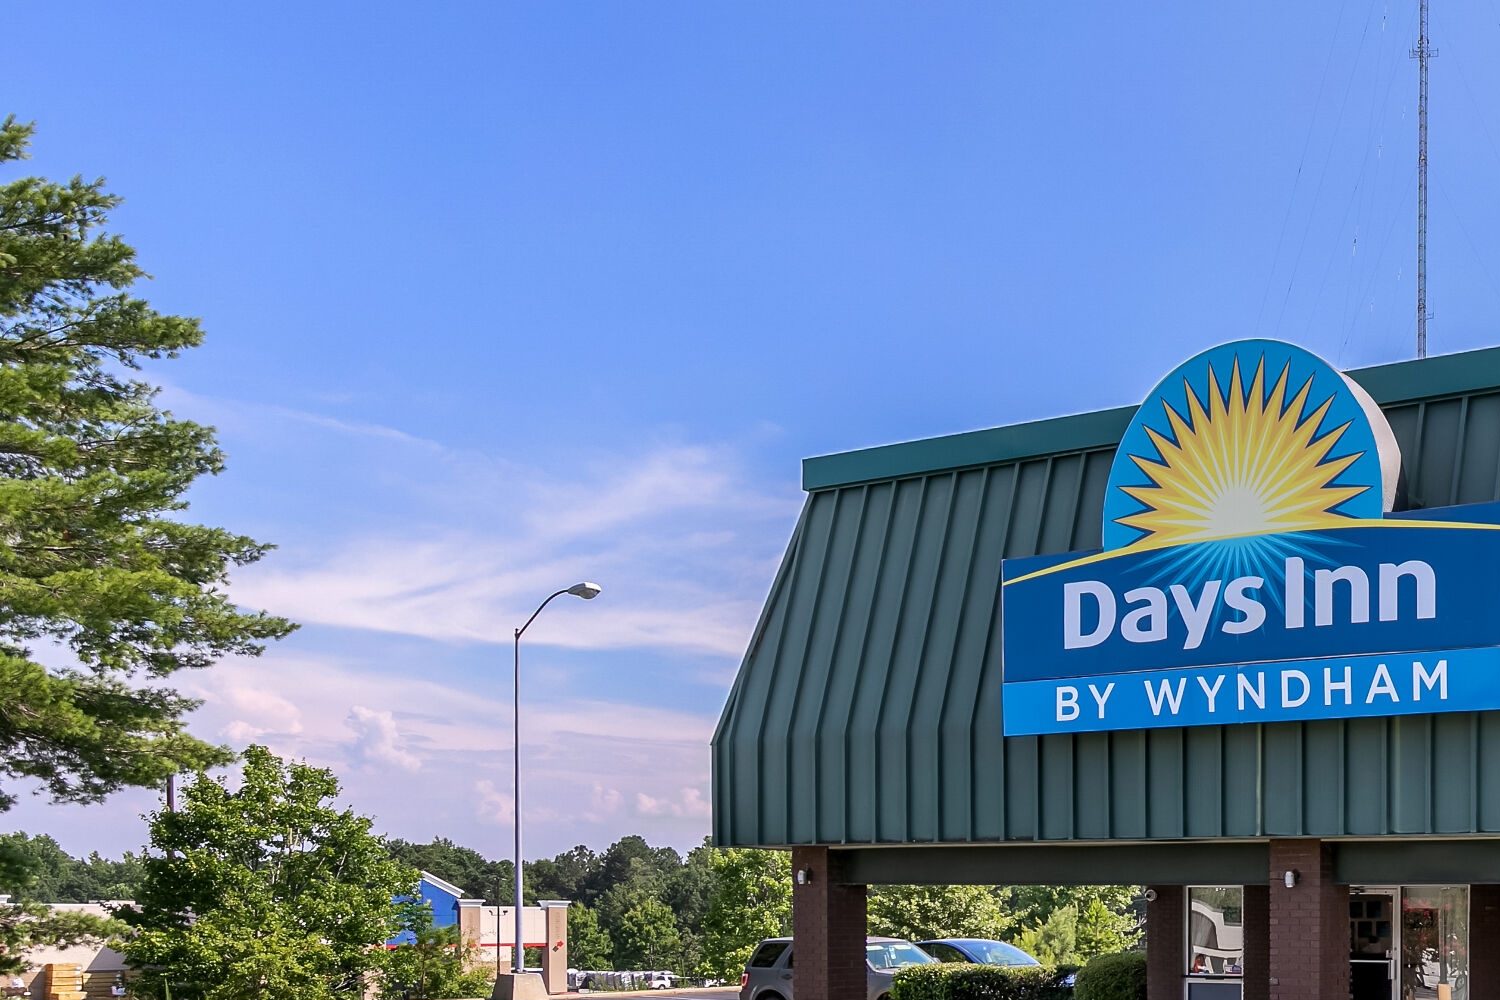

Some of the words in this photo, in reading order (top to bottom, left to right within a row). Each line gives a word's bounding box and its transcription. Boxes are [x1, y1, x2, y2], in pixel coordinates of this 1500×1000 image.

[1063, 576, 1266, 650] Days
[1285, 556, 1436, 629] Inn
[1056, 682, 1115, 722] BY
[1143, 660, 1448, 716] WYNDHAM
